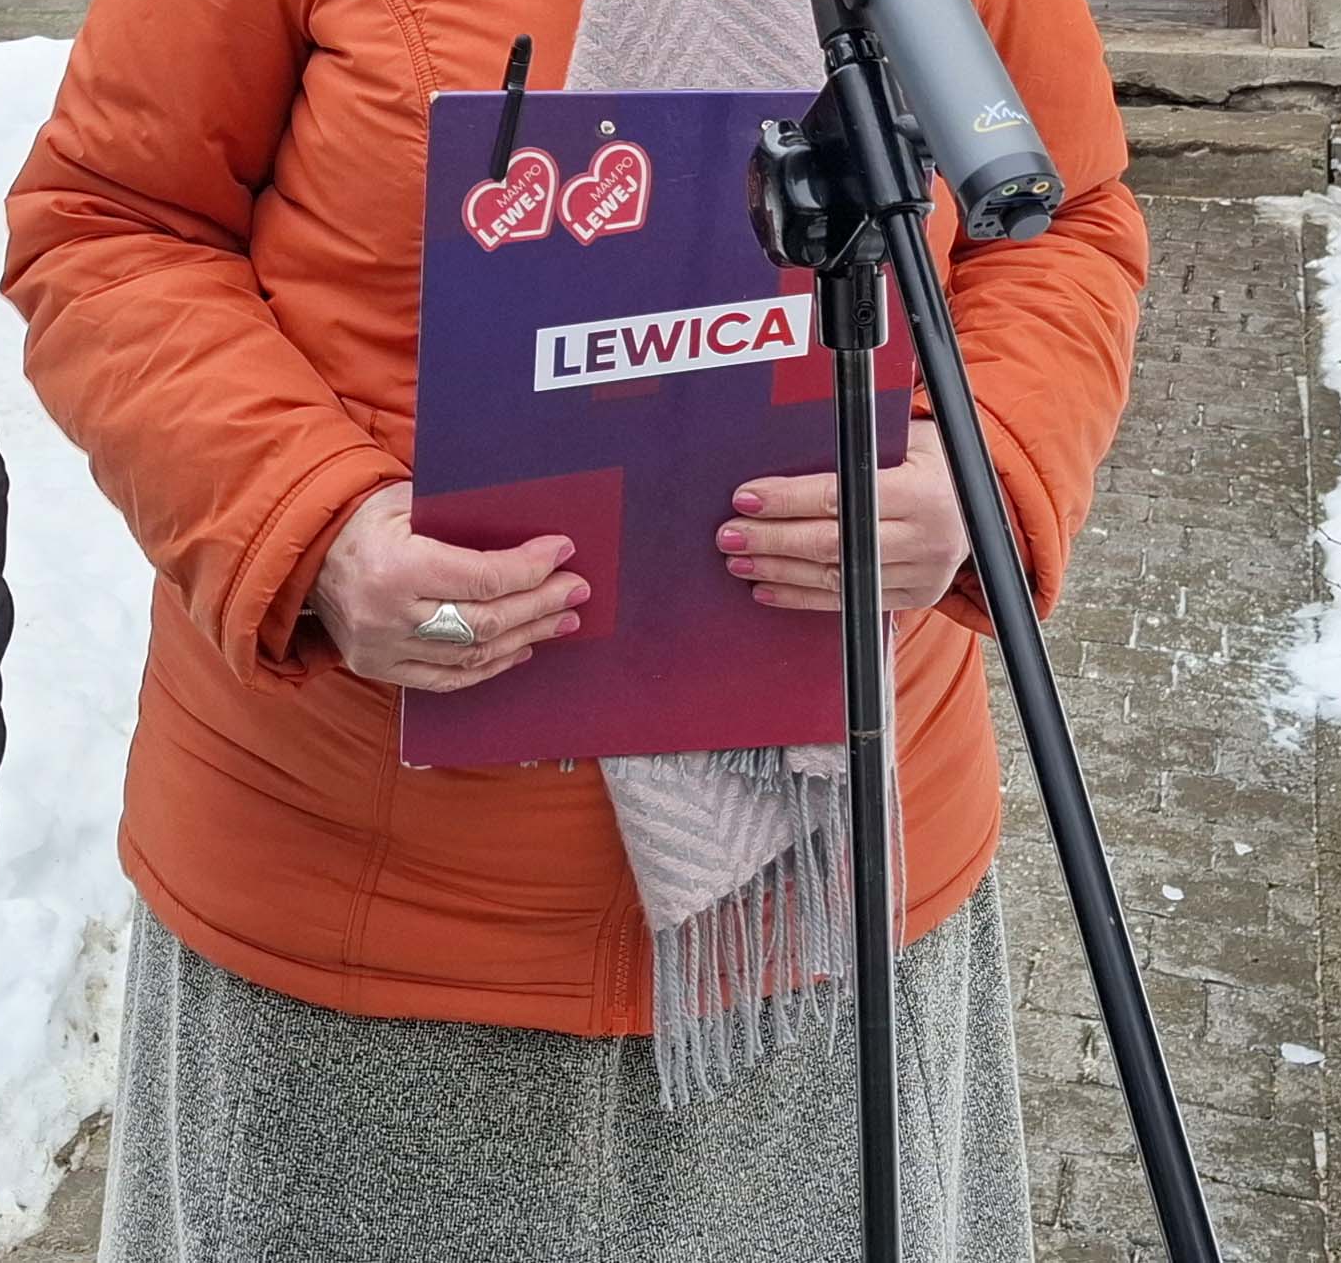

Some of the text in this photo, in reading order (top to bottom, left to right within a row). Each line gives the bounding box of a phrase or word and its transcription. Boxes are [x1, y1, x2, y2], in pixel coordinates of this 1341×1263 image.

[496, 164, 541, 208] MAM PO
[572, 175, 638, 240] LEWEJ
[590, 156, 633, 201] MAM PO
[477, 183, 546, 246] LEWEJ
[552, 305, 796, 379] LEWICA
